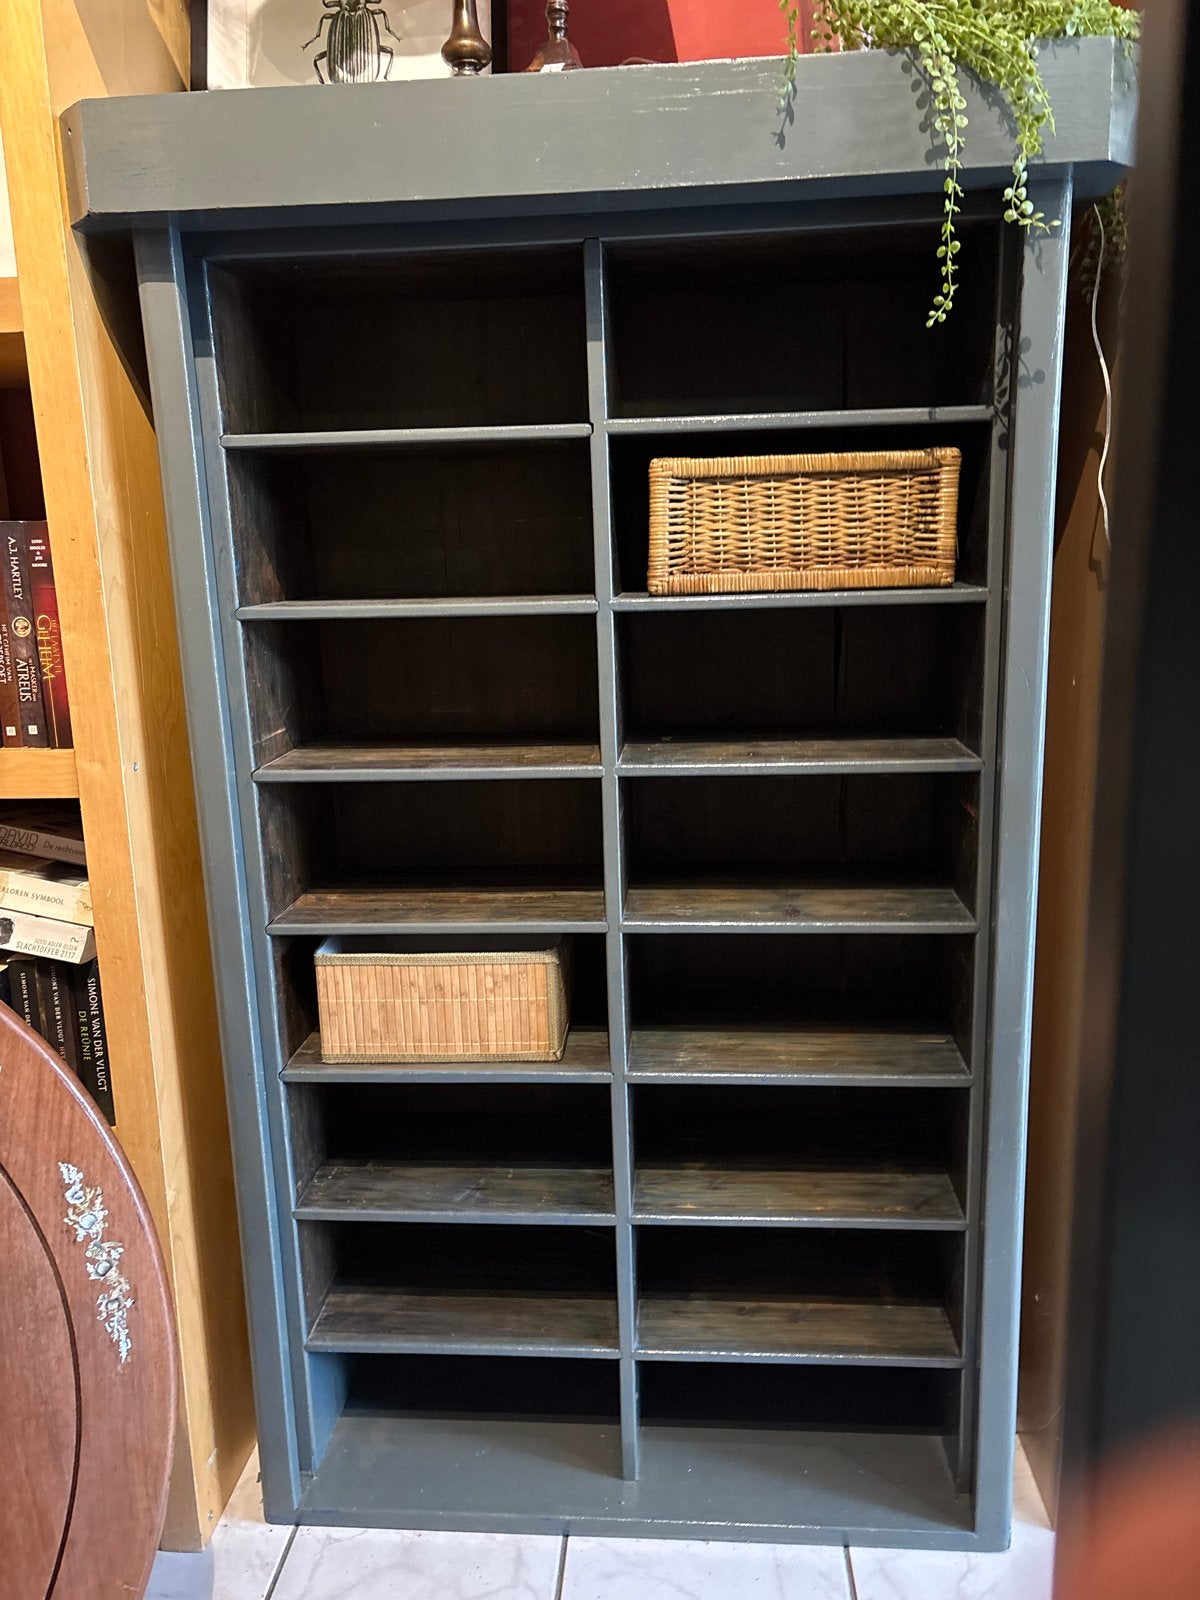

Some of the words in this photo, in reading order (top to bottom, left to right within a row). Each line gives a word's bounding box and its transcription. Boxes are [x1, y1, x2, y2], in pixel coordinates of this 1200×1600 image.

[8, 536, 18, 555] A.J.
[10, 556, 23, 600] HARTLEY
[37, 615, 56, 680] GEHEIM
[16, 658, 32, 702] ATREUS
[29, 665, 38, 693] MASKER
[31, 892, 65, 906] SYMBOOL
[15, 941, 60, 956] SLACHTOFFER
[60, 950, 76, 960] 2117
[20, 972, 29, 999] SIMONE
[87, 977, 99, 1015] SIMONE
[52, 991, 60, 1005] VAN
[53, 1006, 62, 1020] DER
[78, 1010, 88, 1023] DE
[55, 1020, 65, 1043] VLUGT
[91, 1017, 101, 1038] VAN
[93, 1040, 104, 1058] DER
[96, 1059, 108, 1092] VLUGT
